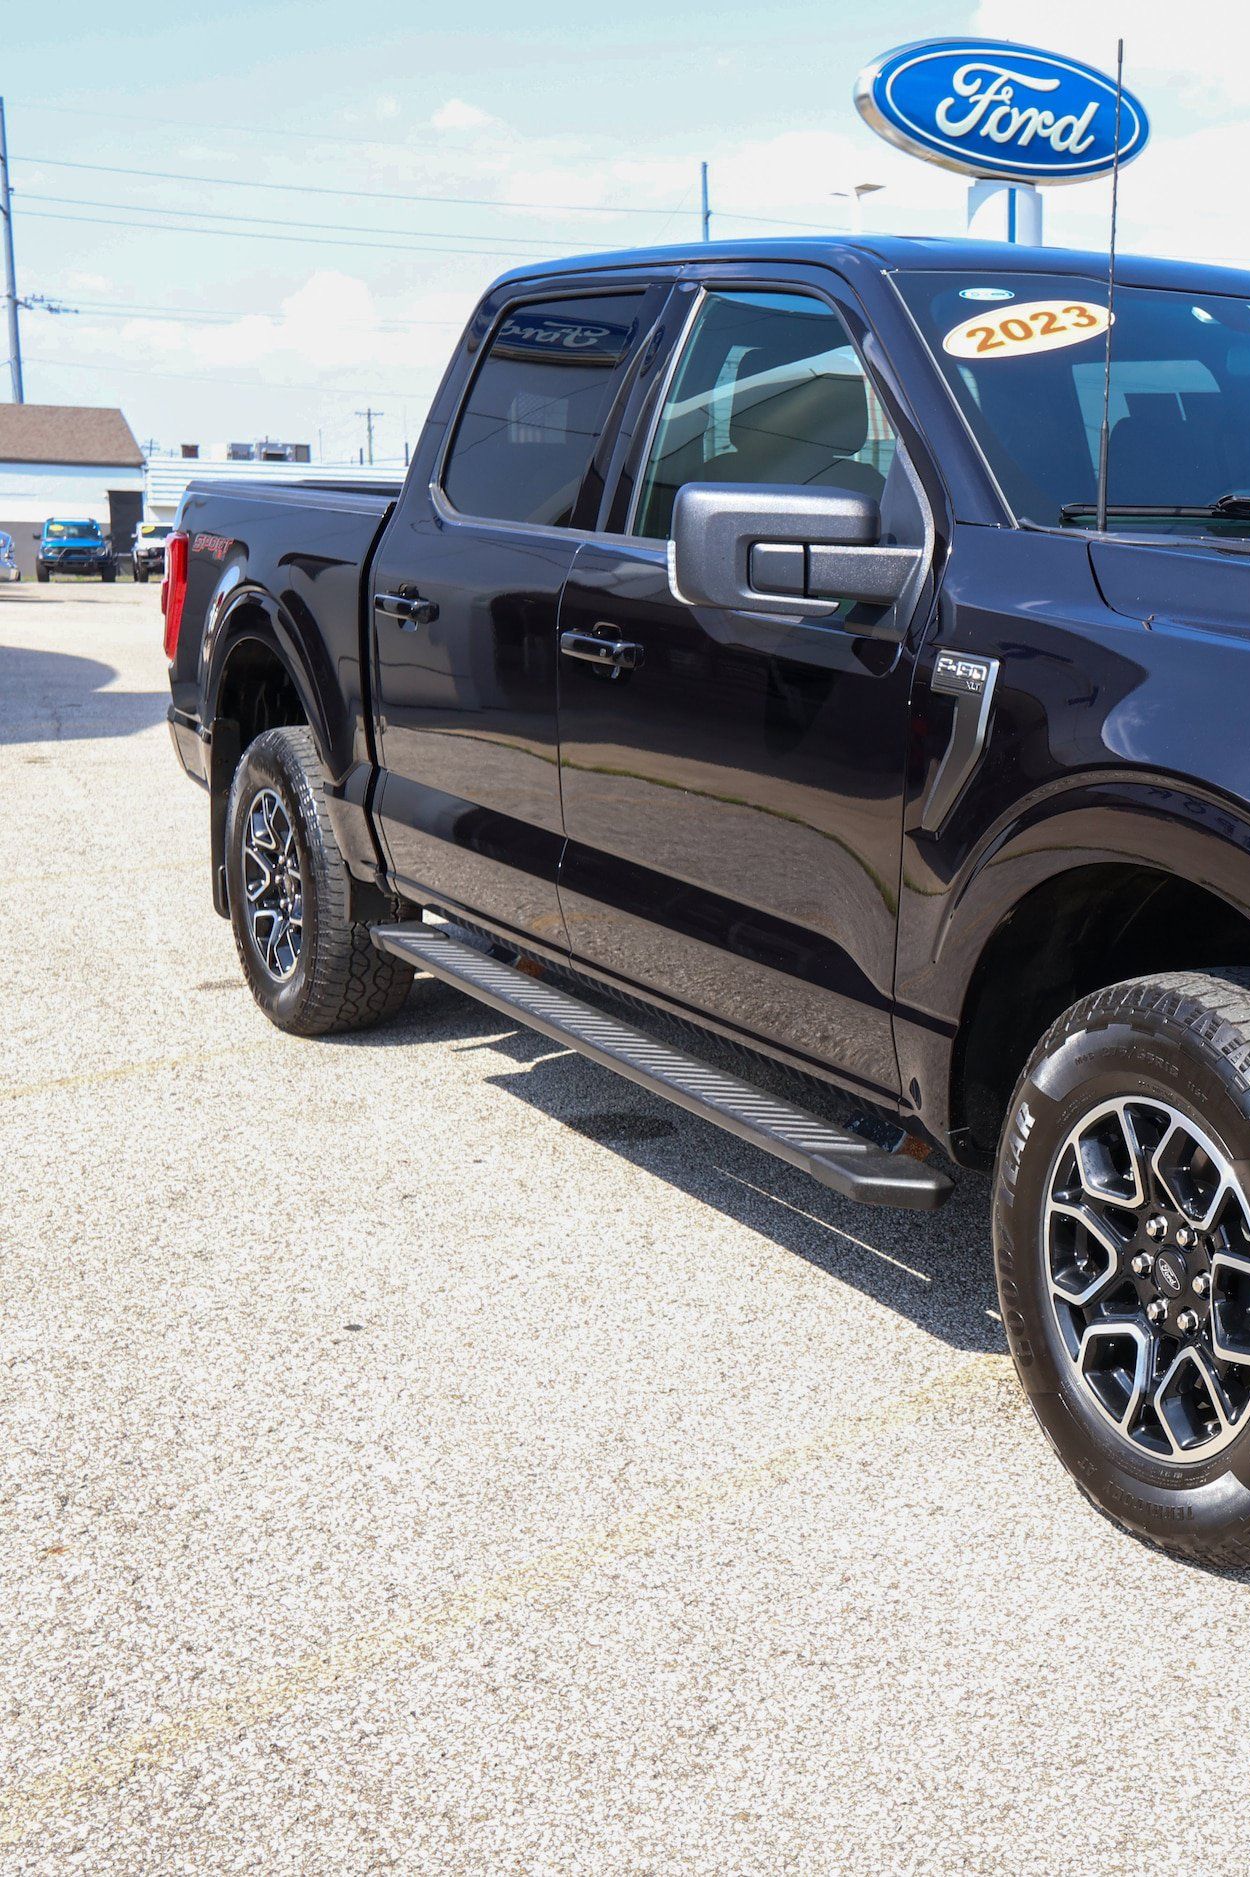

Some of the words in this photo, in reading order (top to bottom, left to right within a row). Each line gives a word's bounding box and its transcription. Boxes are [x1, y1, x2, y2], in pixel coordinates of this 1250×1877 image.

[935, 63, 1099, 154] Ford
[966, 305, 1098, 353] 2023
[1160, 1263, 1177, 1285] Ford
